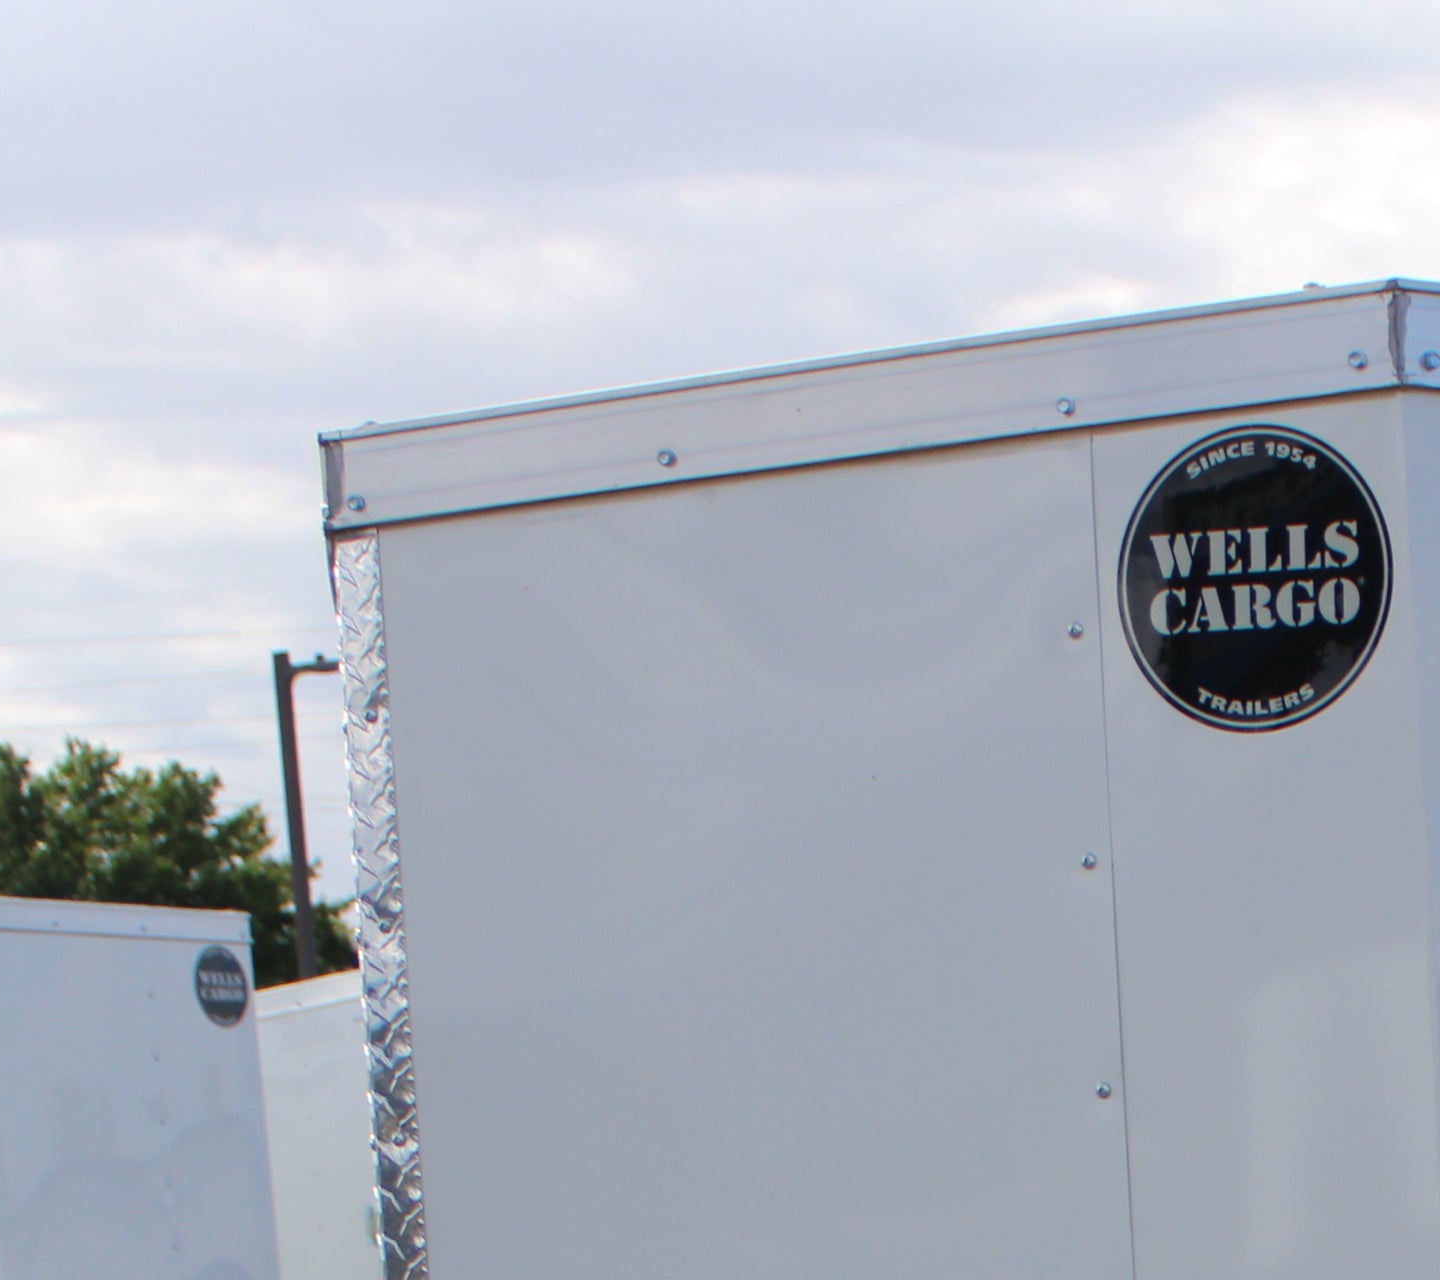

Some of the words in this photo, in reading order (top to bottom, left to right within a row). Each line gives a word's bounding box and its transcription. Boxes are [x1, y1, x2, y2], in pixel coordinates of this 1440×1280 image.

[1186, 440, 1256, 480] SINCE
[1264, 441, 1318, 470] 1954
[1148, 519, 1360, 580] WELLS
[1149, 576, 1362, 636] CARGO
[1196, 682, 1315, 716] TRAILERS
